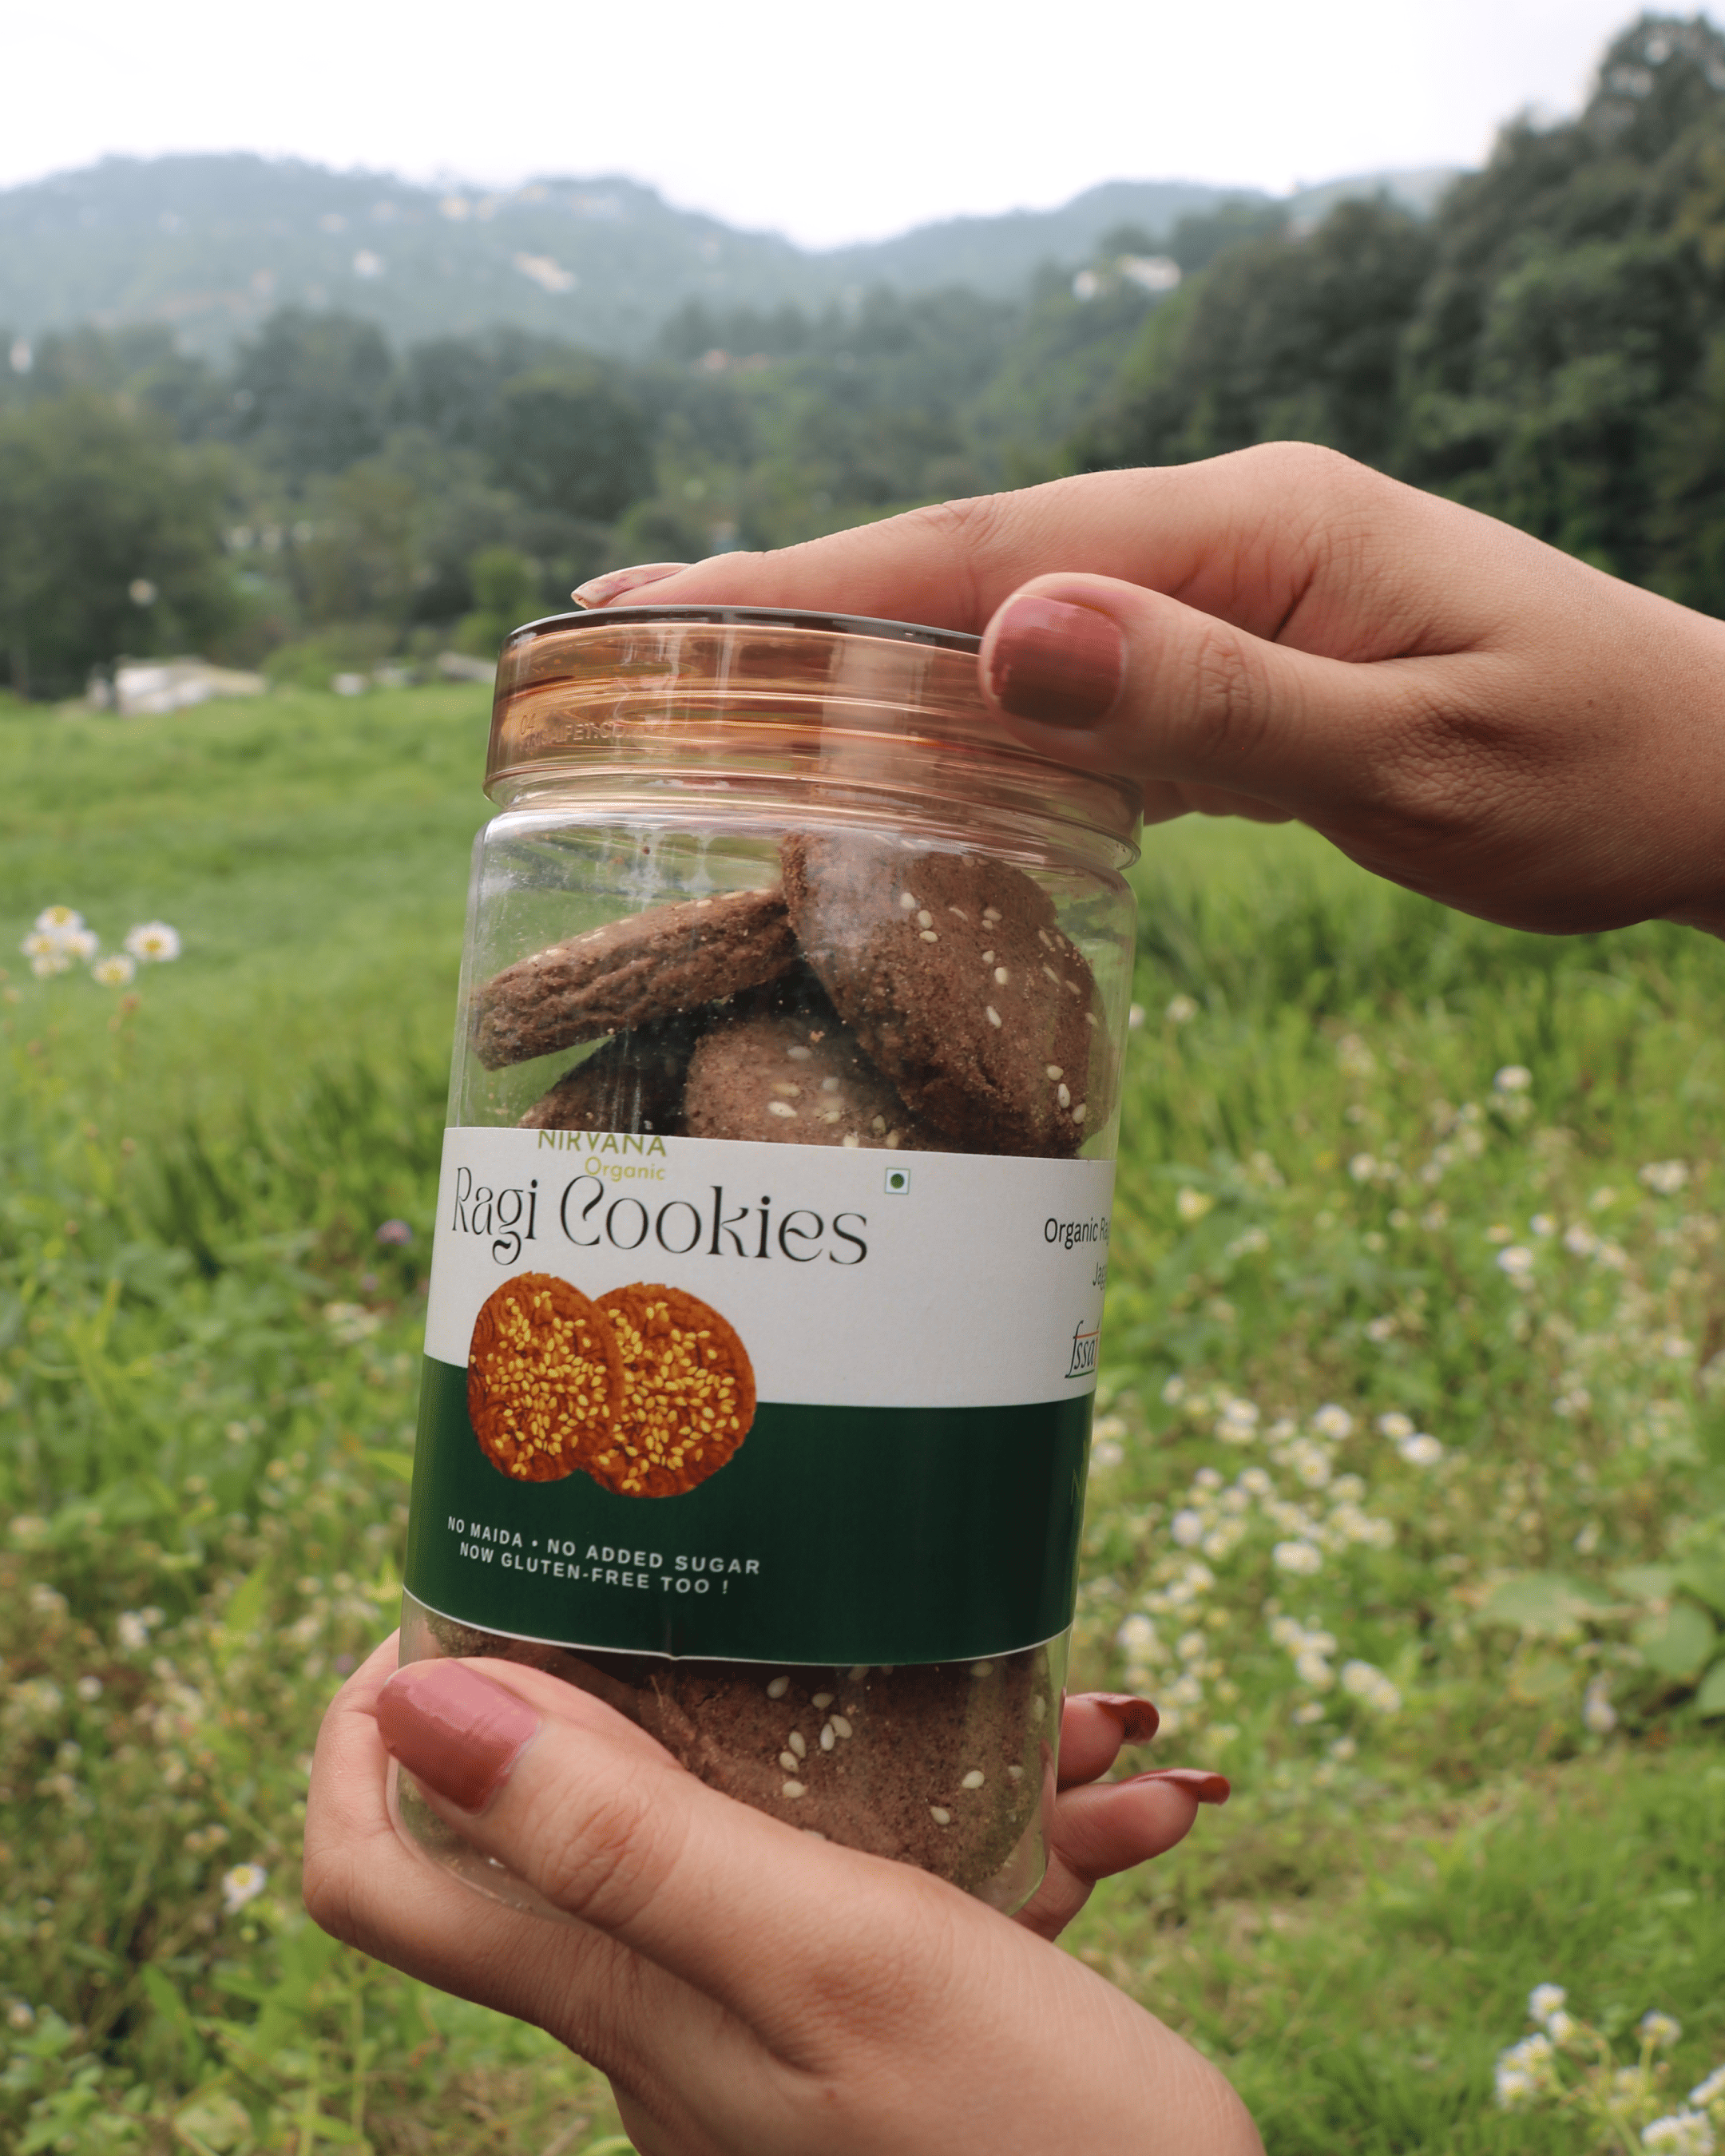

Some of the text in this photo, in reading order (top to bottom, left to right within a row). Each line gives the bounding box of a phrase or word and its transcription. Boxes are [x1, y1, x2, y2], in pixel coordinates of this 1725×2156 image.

[538, 1130, 666, 1157] NIRVANA
[585, 1155, 665, 1182] Organic
[452, 1167, 869, 1265] Ragi Cookies
[1044, 1216, 1099, 1250] Organic
[447, 1516, 760, 1575] NO MAIDA NO ADDED SUGAR
[459, 1541, 494, 1563] NOW
[500, 1552, 650, 1589] GLUTEN-FREE
[660, 1575, 710, 1594] TOO
